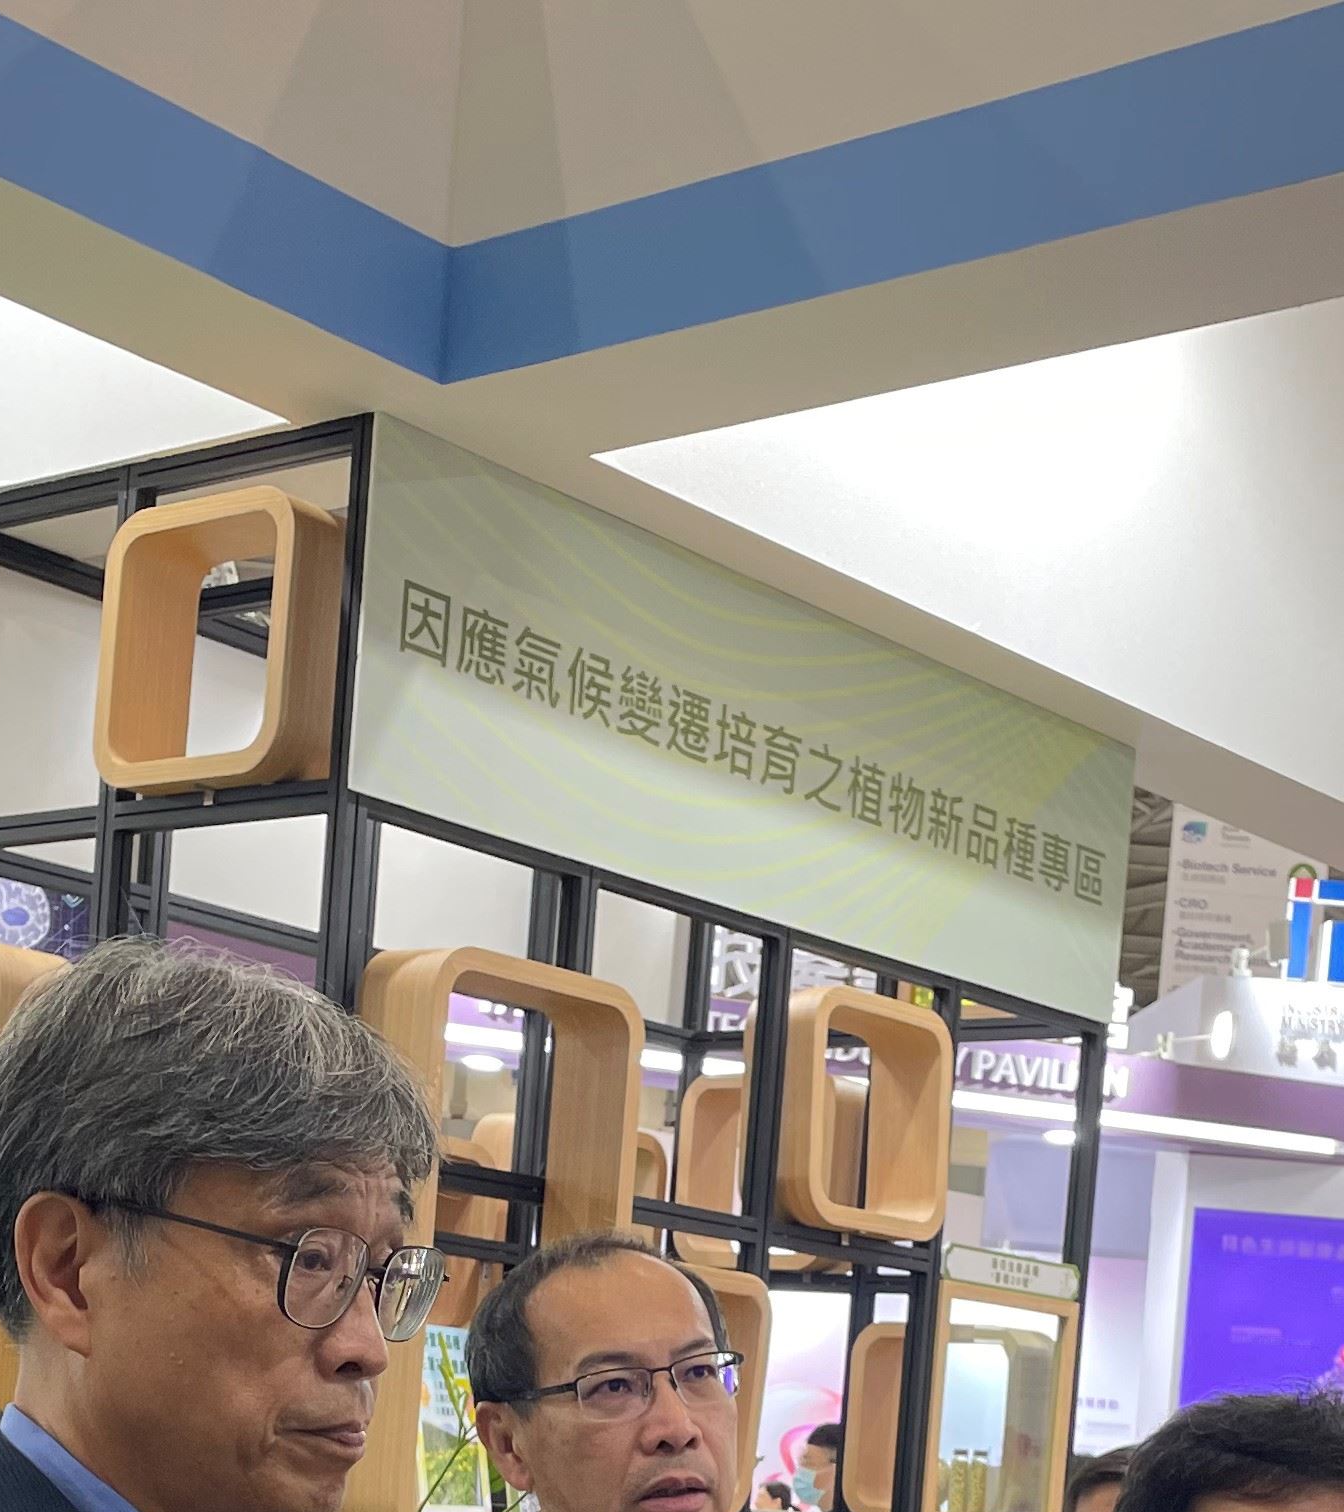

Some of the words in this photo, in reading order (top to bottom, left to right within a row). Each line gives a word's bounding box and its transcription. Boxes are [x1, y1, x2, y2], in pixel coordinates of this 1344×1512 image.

[398, 578, 1106, 908] 因應氣候變遷培育之植物新品種專區
